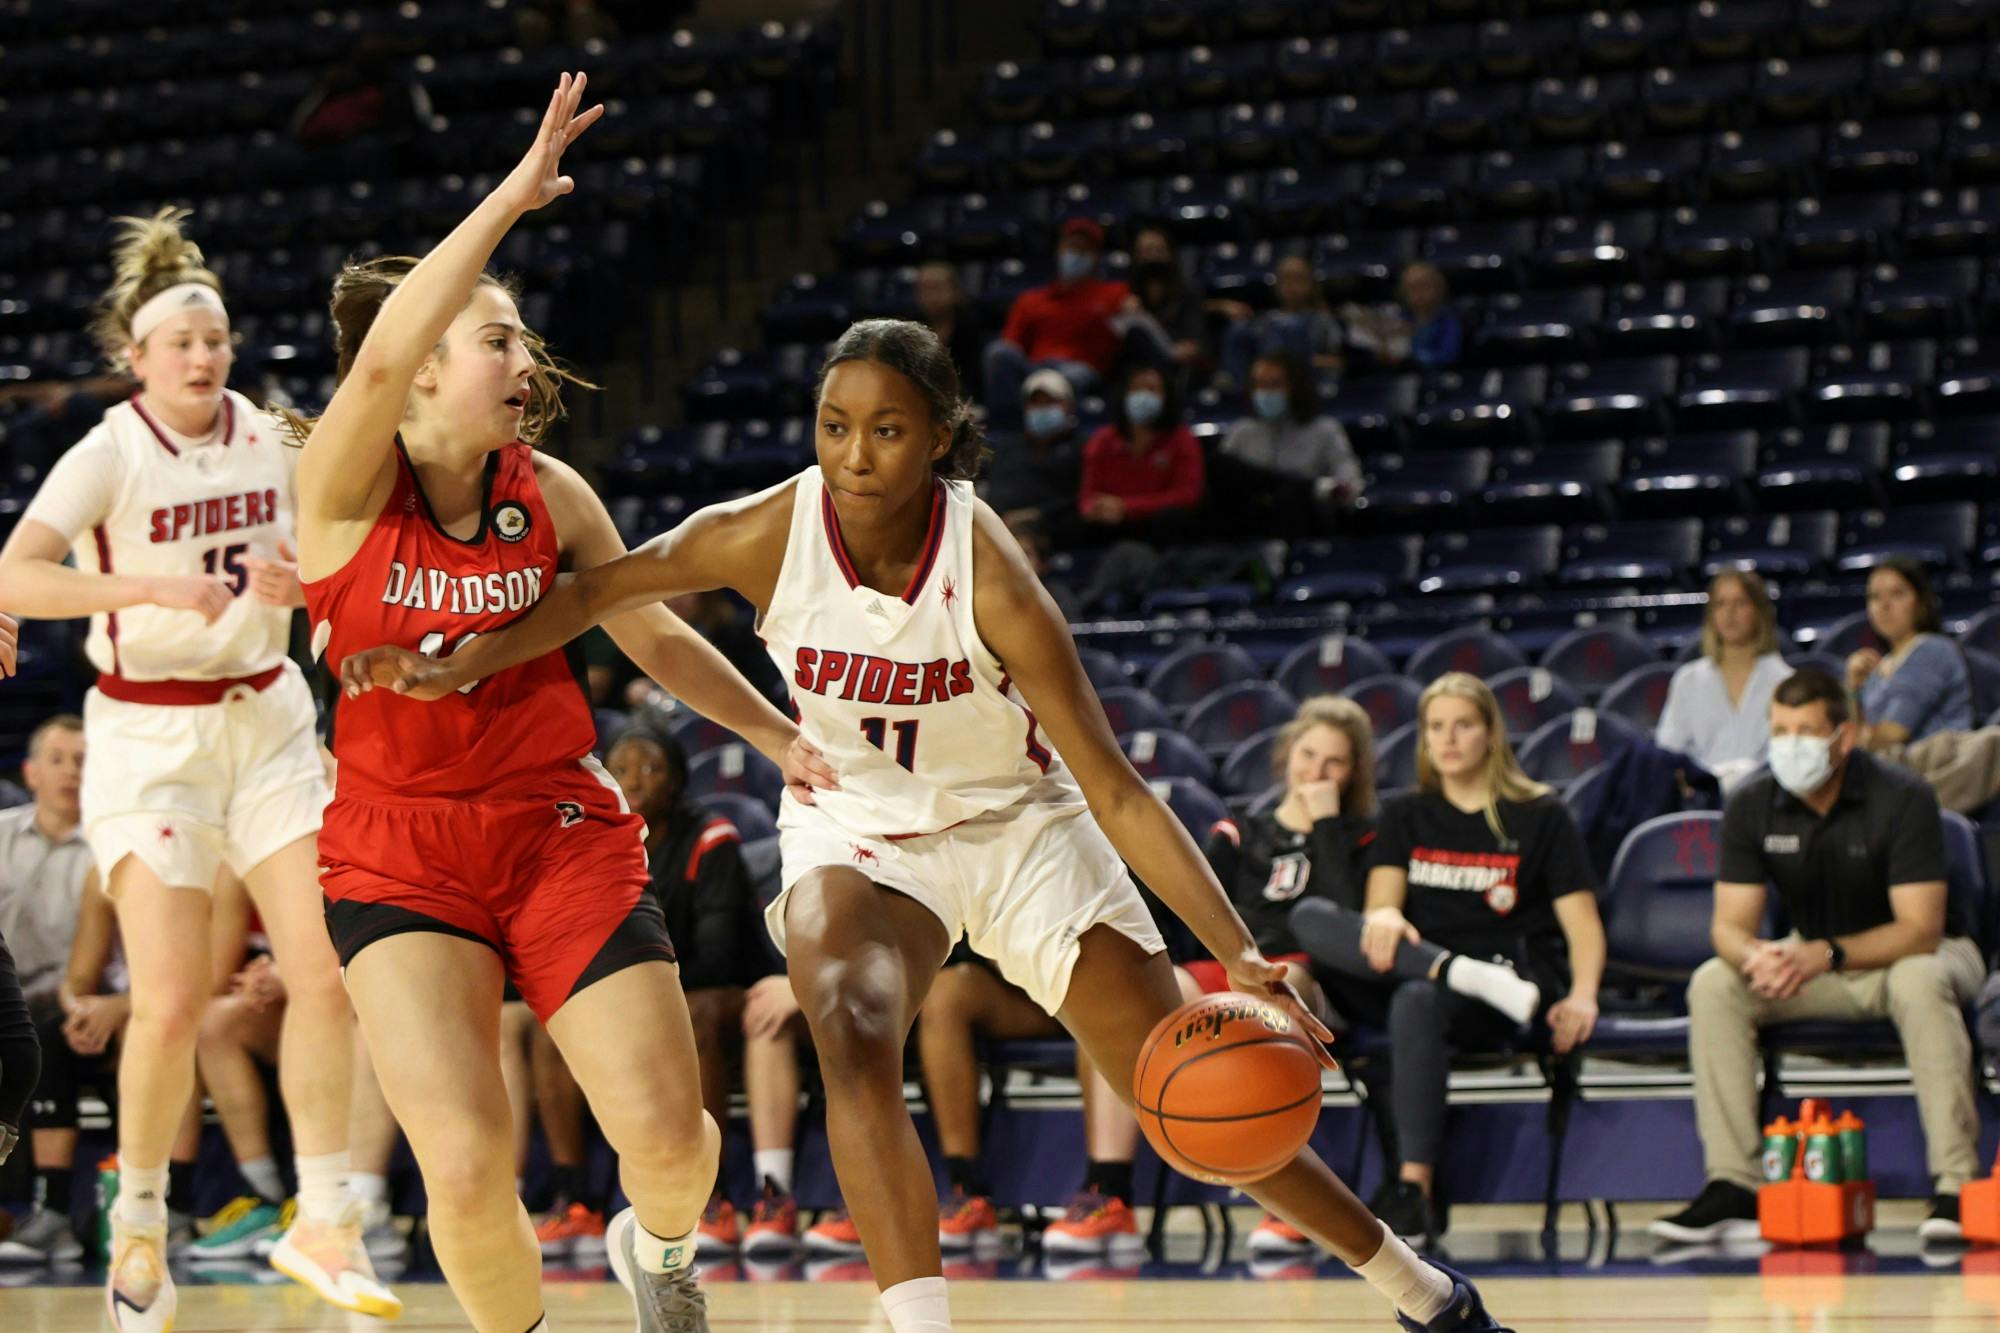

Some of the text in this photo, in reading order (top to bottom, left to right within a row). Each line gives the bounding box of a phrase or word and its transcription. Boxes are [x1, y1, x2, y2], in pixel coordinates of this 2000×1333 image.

[150, 488, 277, 543] SPIDERS
[202, 543, 249, 598] 15
[381, 561, 543, 614] DAVIDSON
[794, 646, 974, 706] SPIDERS
[859, 716, 919, 774] 11
